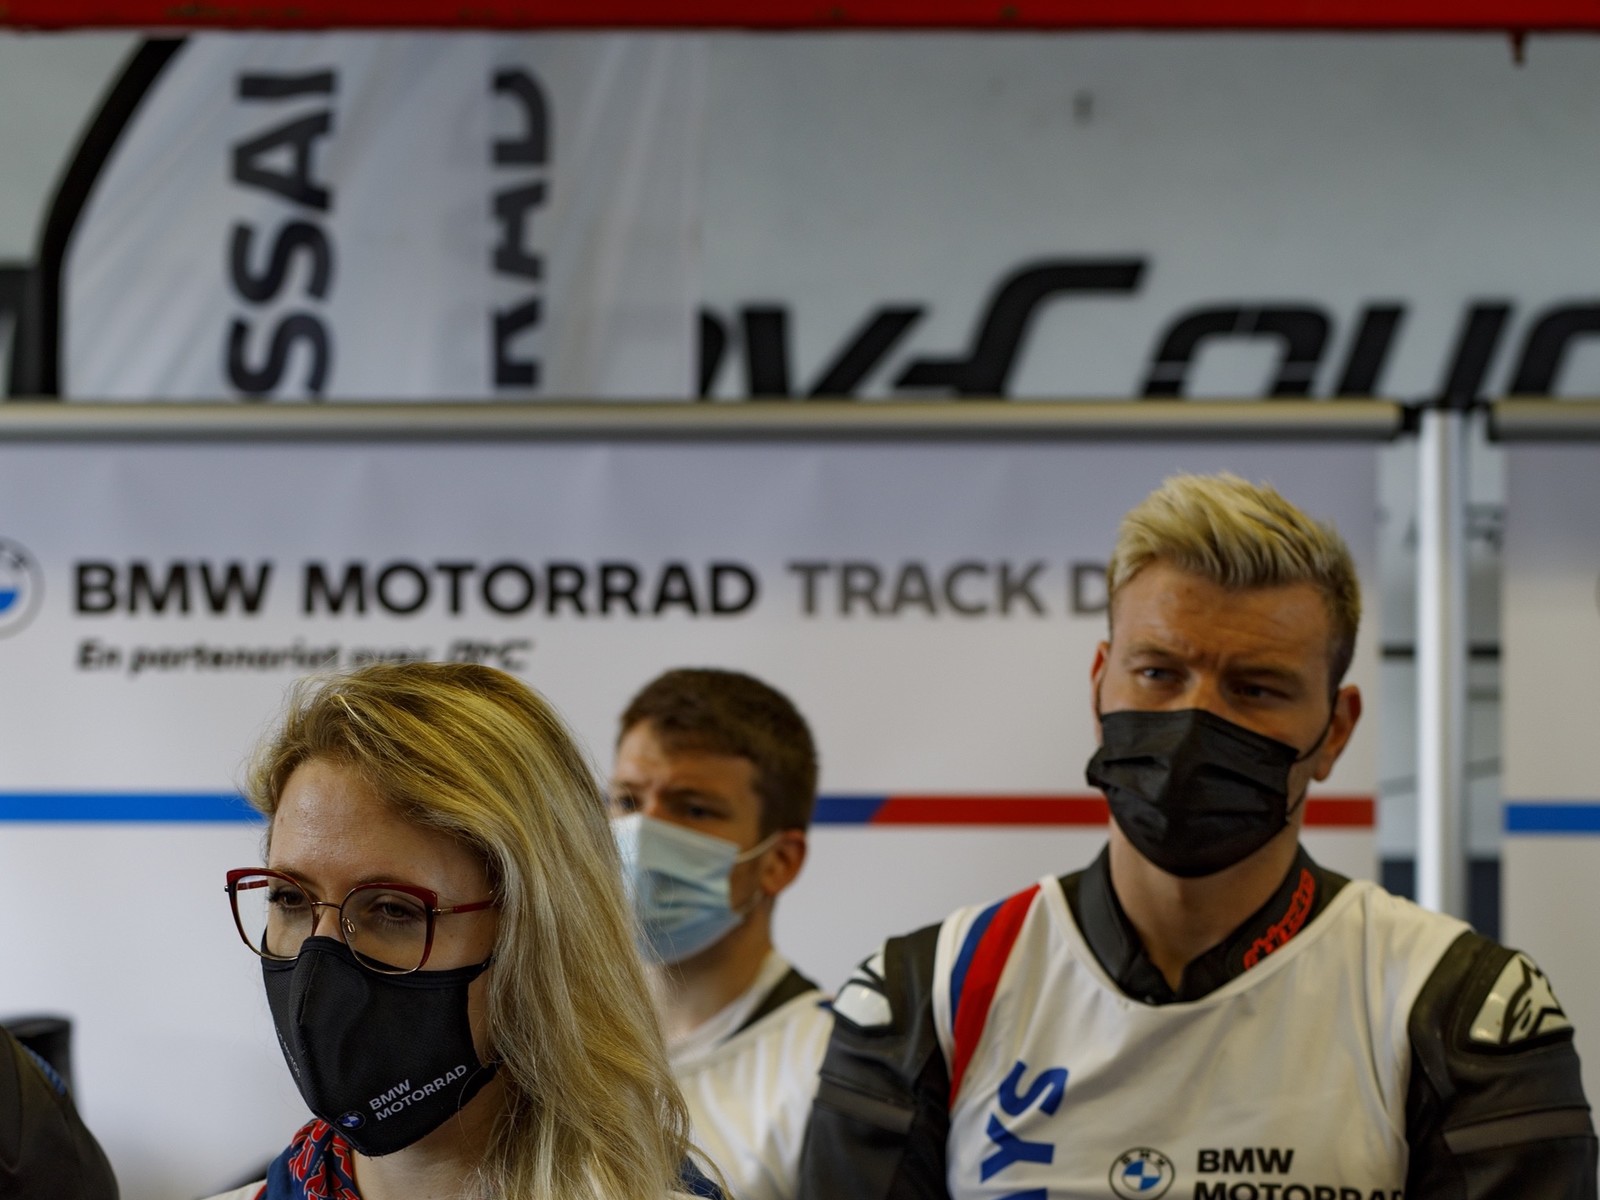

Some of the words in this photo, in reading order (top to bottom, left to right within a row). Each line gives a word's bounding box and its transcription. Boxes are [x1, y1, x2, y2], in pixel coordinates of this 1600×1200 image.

[73, 560, 273, 616] BMW
[303, 560, 759, 617] MOTORRAD
[786, 560, 1049, 617] TRACK
[369, 1079, 411, 1111] BMW
[375, 1064, 467, 1121] MOTORRAD
[1197, 1148, 1294, 1174] BMW
